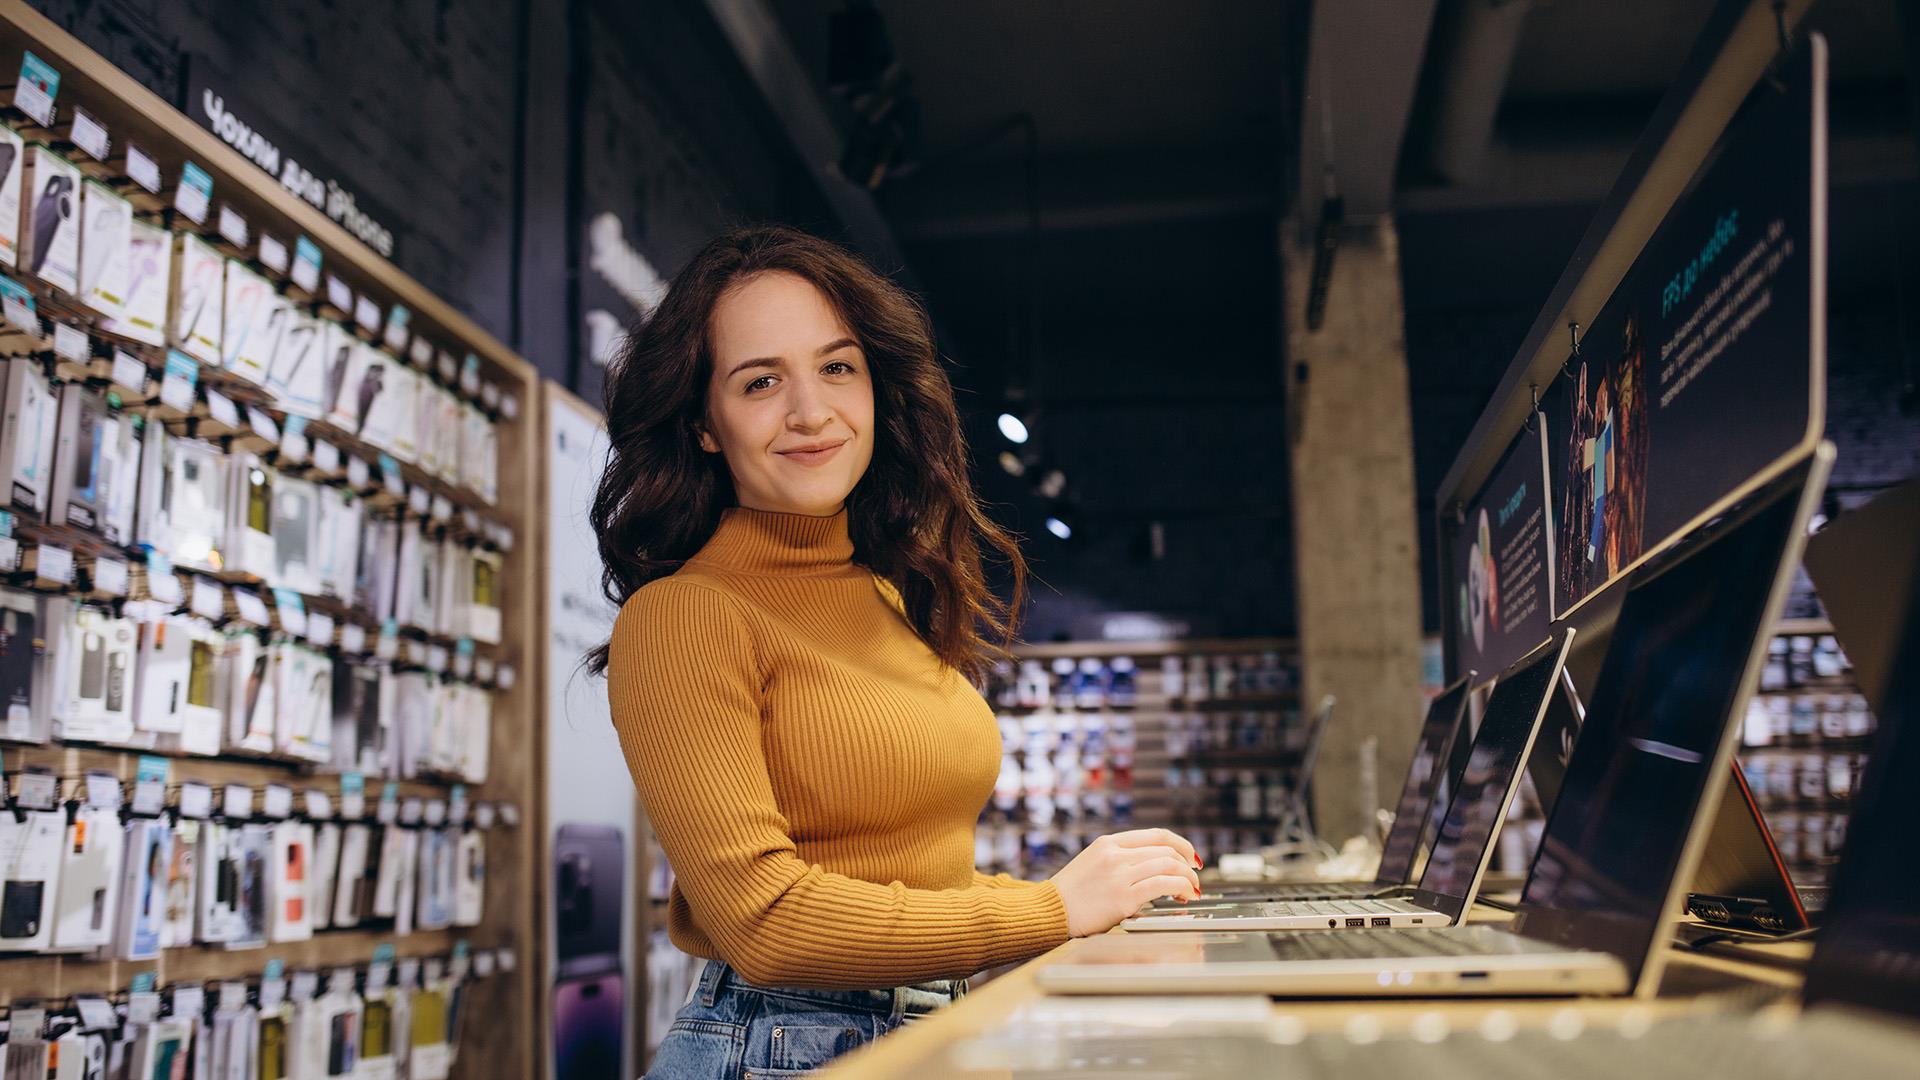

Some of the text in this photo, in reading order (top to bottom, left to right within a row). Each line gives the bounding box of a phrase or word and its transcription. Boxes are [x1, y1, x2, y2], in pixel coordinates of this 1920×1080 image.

[203, 88, 279, 175] Чохли
[280, 158, 325, 209] для
[326, 179, 393, 257] iPhone
[1662, 209, 1738, 318] FPS до небес
